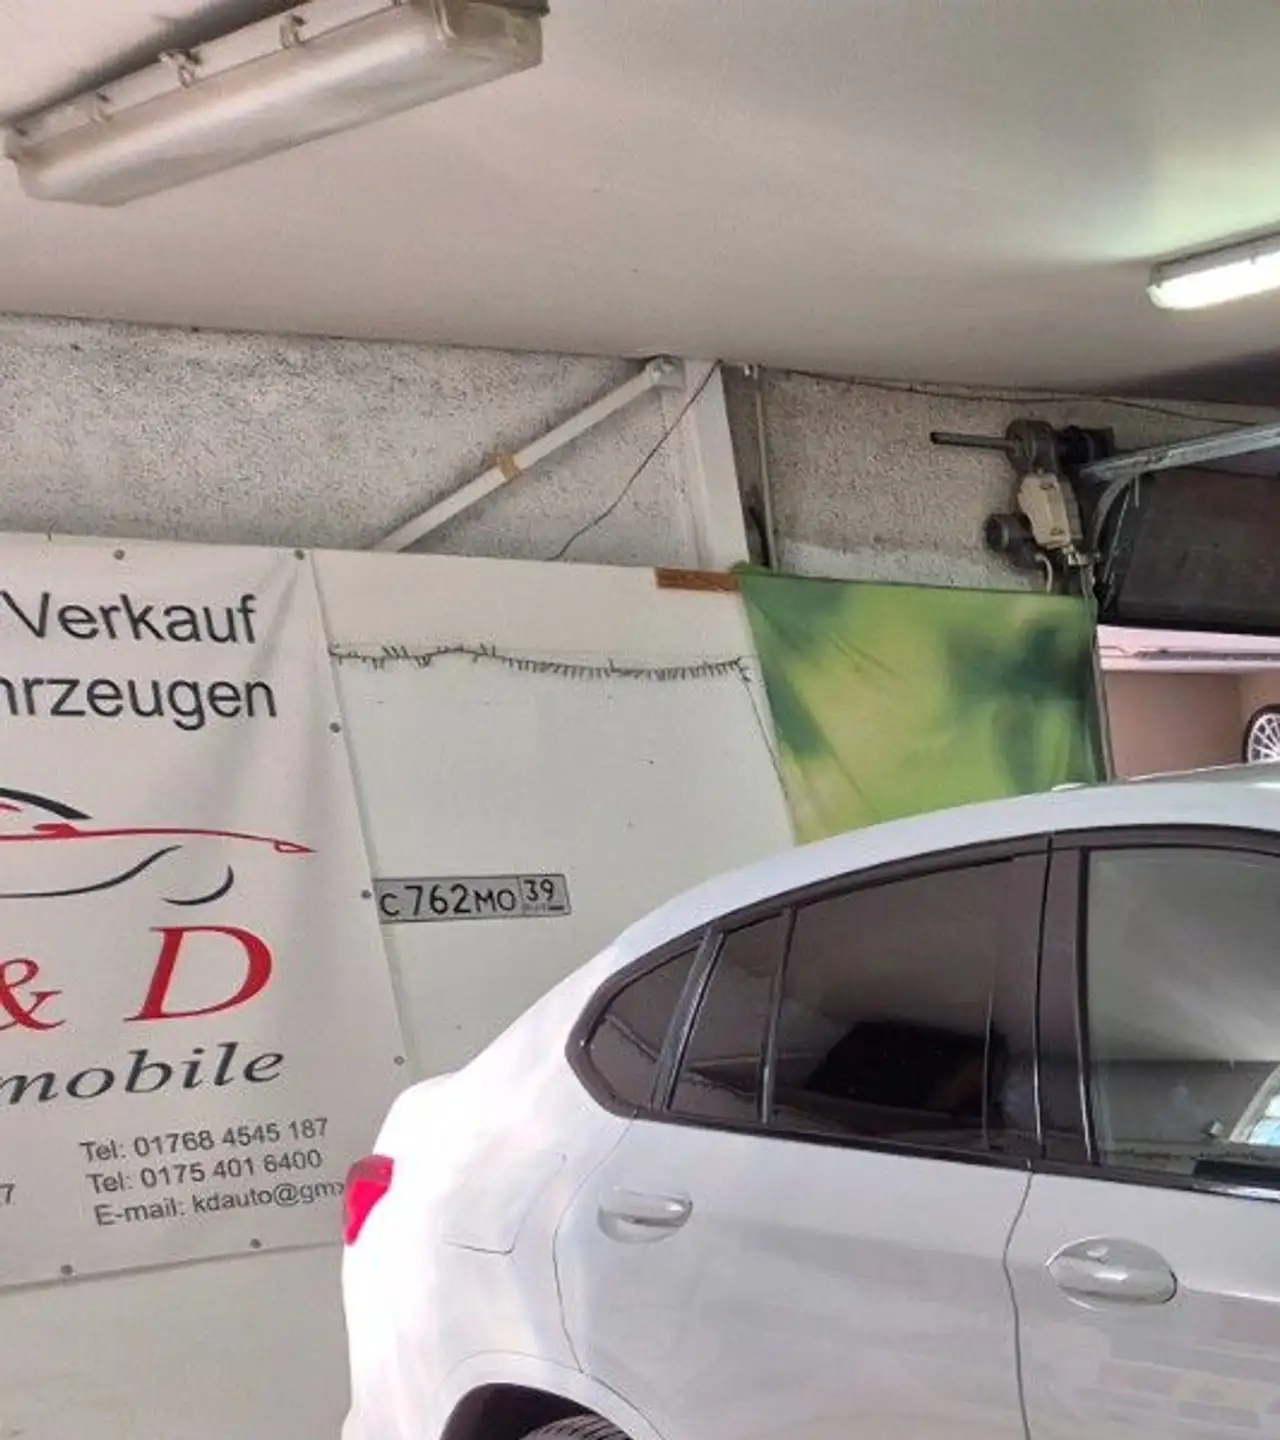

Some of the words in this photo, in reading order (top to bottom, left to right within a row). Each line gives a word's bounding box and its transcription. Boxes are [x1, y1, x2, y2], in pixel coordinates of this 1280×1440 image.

[0, 589, 257, 644] Verkauf
[523, 879, 554, 901] 39
[123, 925, 273, 1021] D
[79, 1140, 126, 1164] Tel:
[134, 1131, 215, 1158] 01768
[222, 1122, 280, 1146] 4545
[287, 1117, 328, 1139] 187
[86, 1172, 133, 1195] Tel:
[140, 1162, 206, 1188] 0175
[213, 1157, 255, 1179] 401
[264, 1149, 322, 1172] 6400
[94, 1194, 185, 1226] E-mail:
